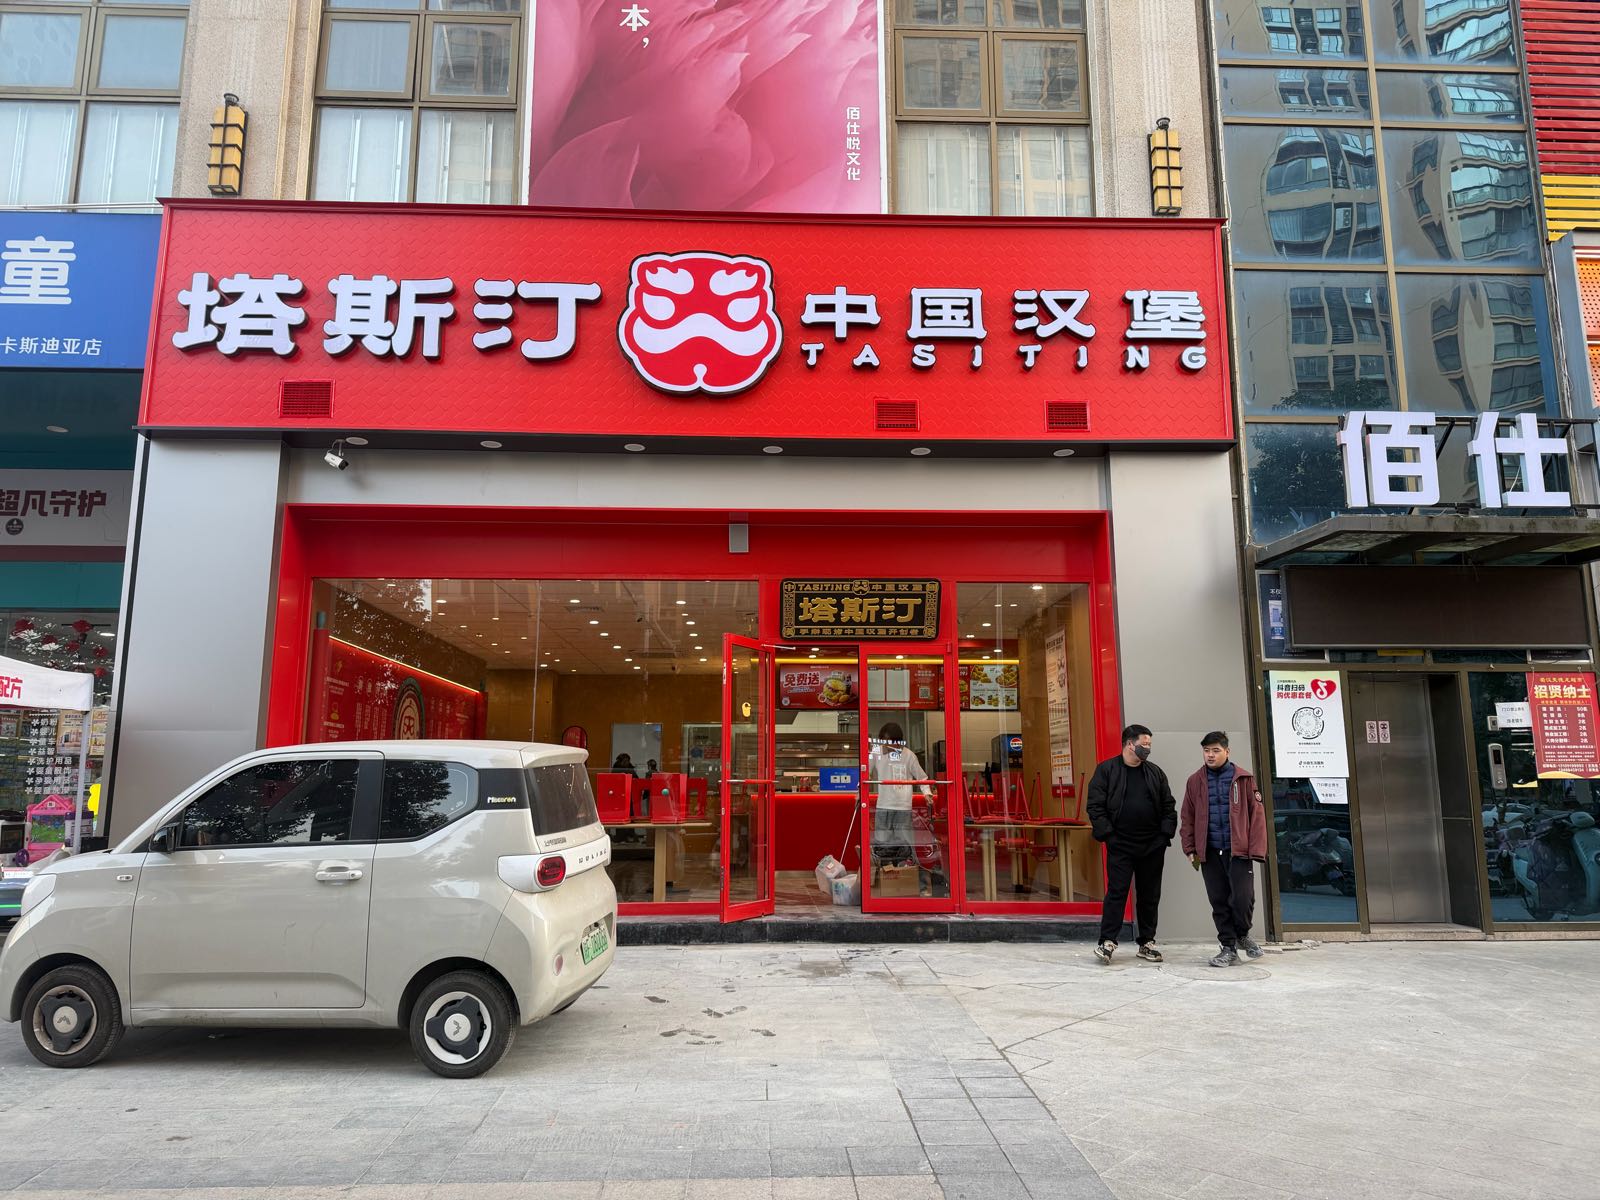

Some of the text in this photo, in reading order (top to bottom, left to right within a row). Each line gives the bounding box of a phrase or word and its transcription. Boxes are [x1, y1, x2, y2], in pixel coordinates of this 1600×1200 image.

[846, 106, 860, 181] 佰仕悦文化
[0, 236, 76, 305] 童
[172, 272, 602, 361] 塔斯汀
[801, 286, 1207, 341] 中国汉堡
[0, 336, 102, 356] 卡斯迪亚店
[801, 343, 1208, 371] TASITING
[1337, 411, 1571, 509] 佰仕
[0, 489, 107, 517] 超凡守护
[798, 583, 850, 591] TASITING
[799, 597, 922, 623] 塔斯汀
[1276, 692, 1312, 700] 购优惠套餐
[1534, 684, 1591, 699] 招贤纳士
